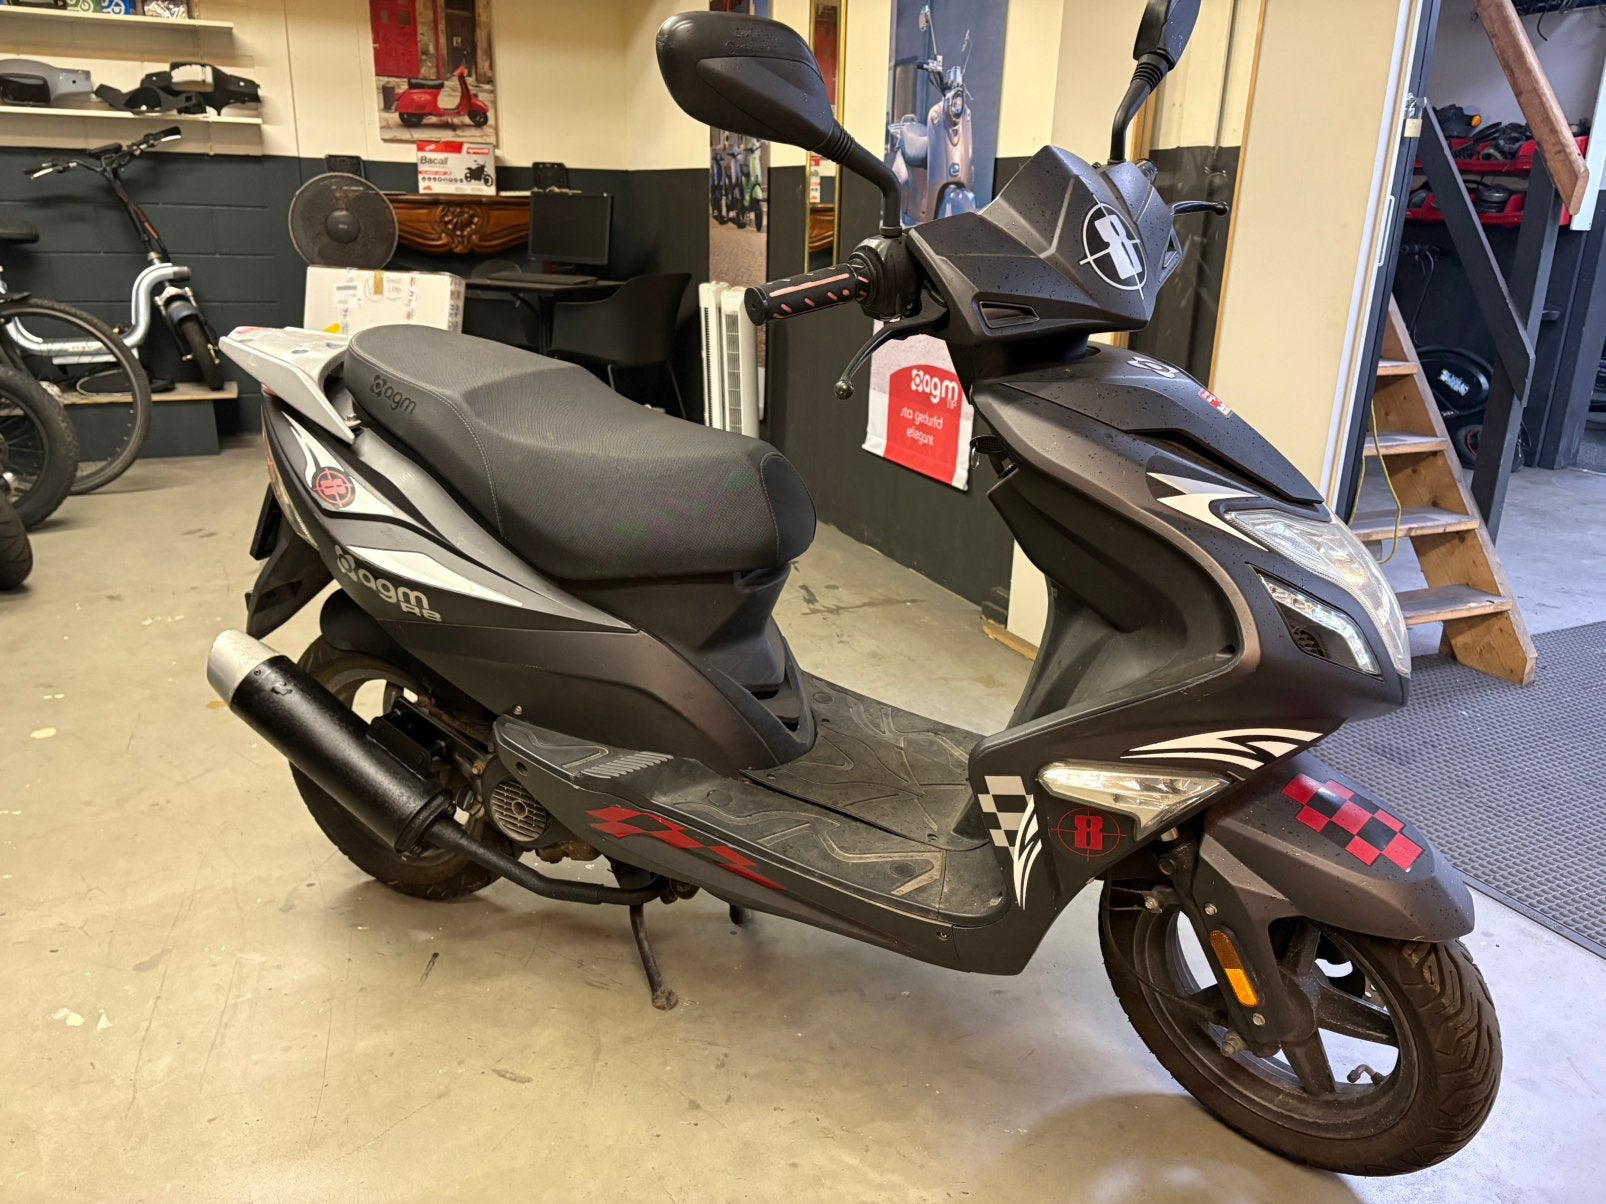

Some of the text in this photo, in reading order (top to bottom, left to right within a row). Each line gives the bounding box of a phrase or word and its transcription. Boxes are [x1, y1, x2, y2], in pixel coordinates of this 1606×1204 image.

[1094, 214, 1143, 280] 8
[384, 386, 417, 415] agm
[923, 373, 959, 404] agm
[906, 426, 935, 446] elegant
[357, 568, 430, 610] agm
[1074, 814, 1104, 851] 8
